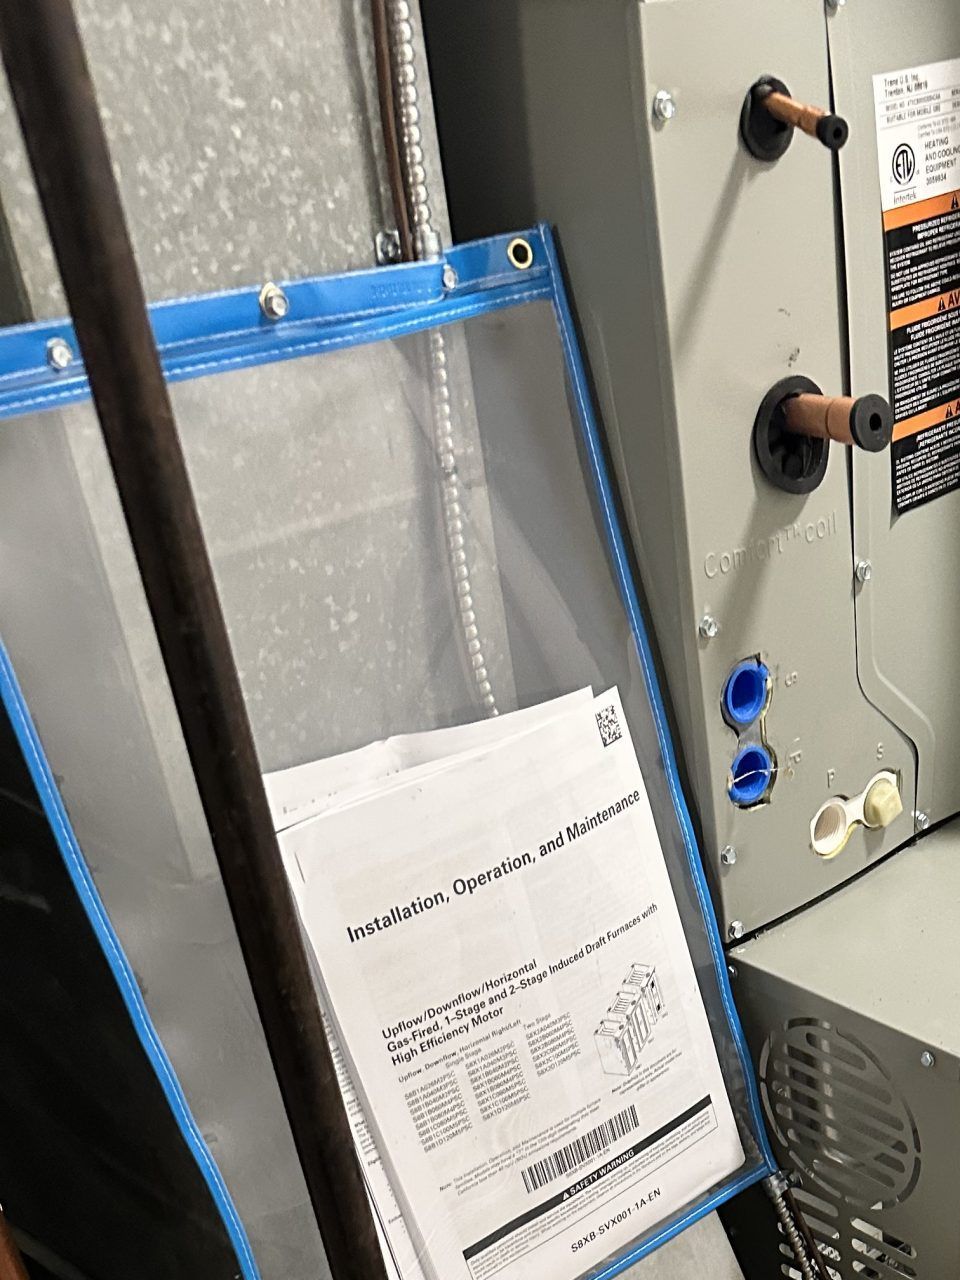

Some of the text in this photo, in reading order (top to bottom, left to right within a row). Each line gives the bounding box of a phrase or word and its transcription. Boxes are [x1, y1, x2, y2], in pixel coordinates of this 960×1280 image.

[924, 136, 948, 150] HEATING
[925, 144, 960, 162] AND COOLING
[925, 157, 956, 174] EQUIPMENT
[346, 789, 640, 943] Installation, Operation, and Maintenance
[386, 1019, 443, 1053] Gas-Fired,
[487, 988, 507, 1005] and
[548, 947, 584, 974] Induced
[584, 934, 606, 954] Draft
[606, 914, 640, 941] Furnaces
[641, 901, 658, 919] with
[381, 958, 537, 1041] Upflow/Downflow/Horizontal
[390, 1005, 504, 1067] High Efficiency Motor
[459, 1033, 490, 1052] Horizontal
[491, 1018, 521, 1037] Right/Left
[522, 1012, 551, 1030] Two Stage
[445, 1046, 482, 1069] Single Stage
[569, 1148, 634, 1196] SAFETY WARNING
[570, 1187, 661, 1253] S8XB-SVX001-1A-EN
